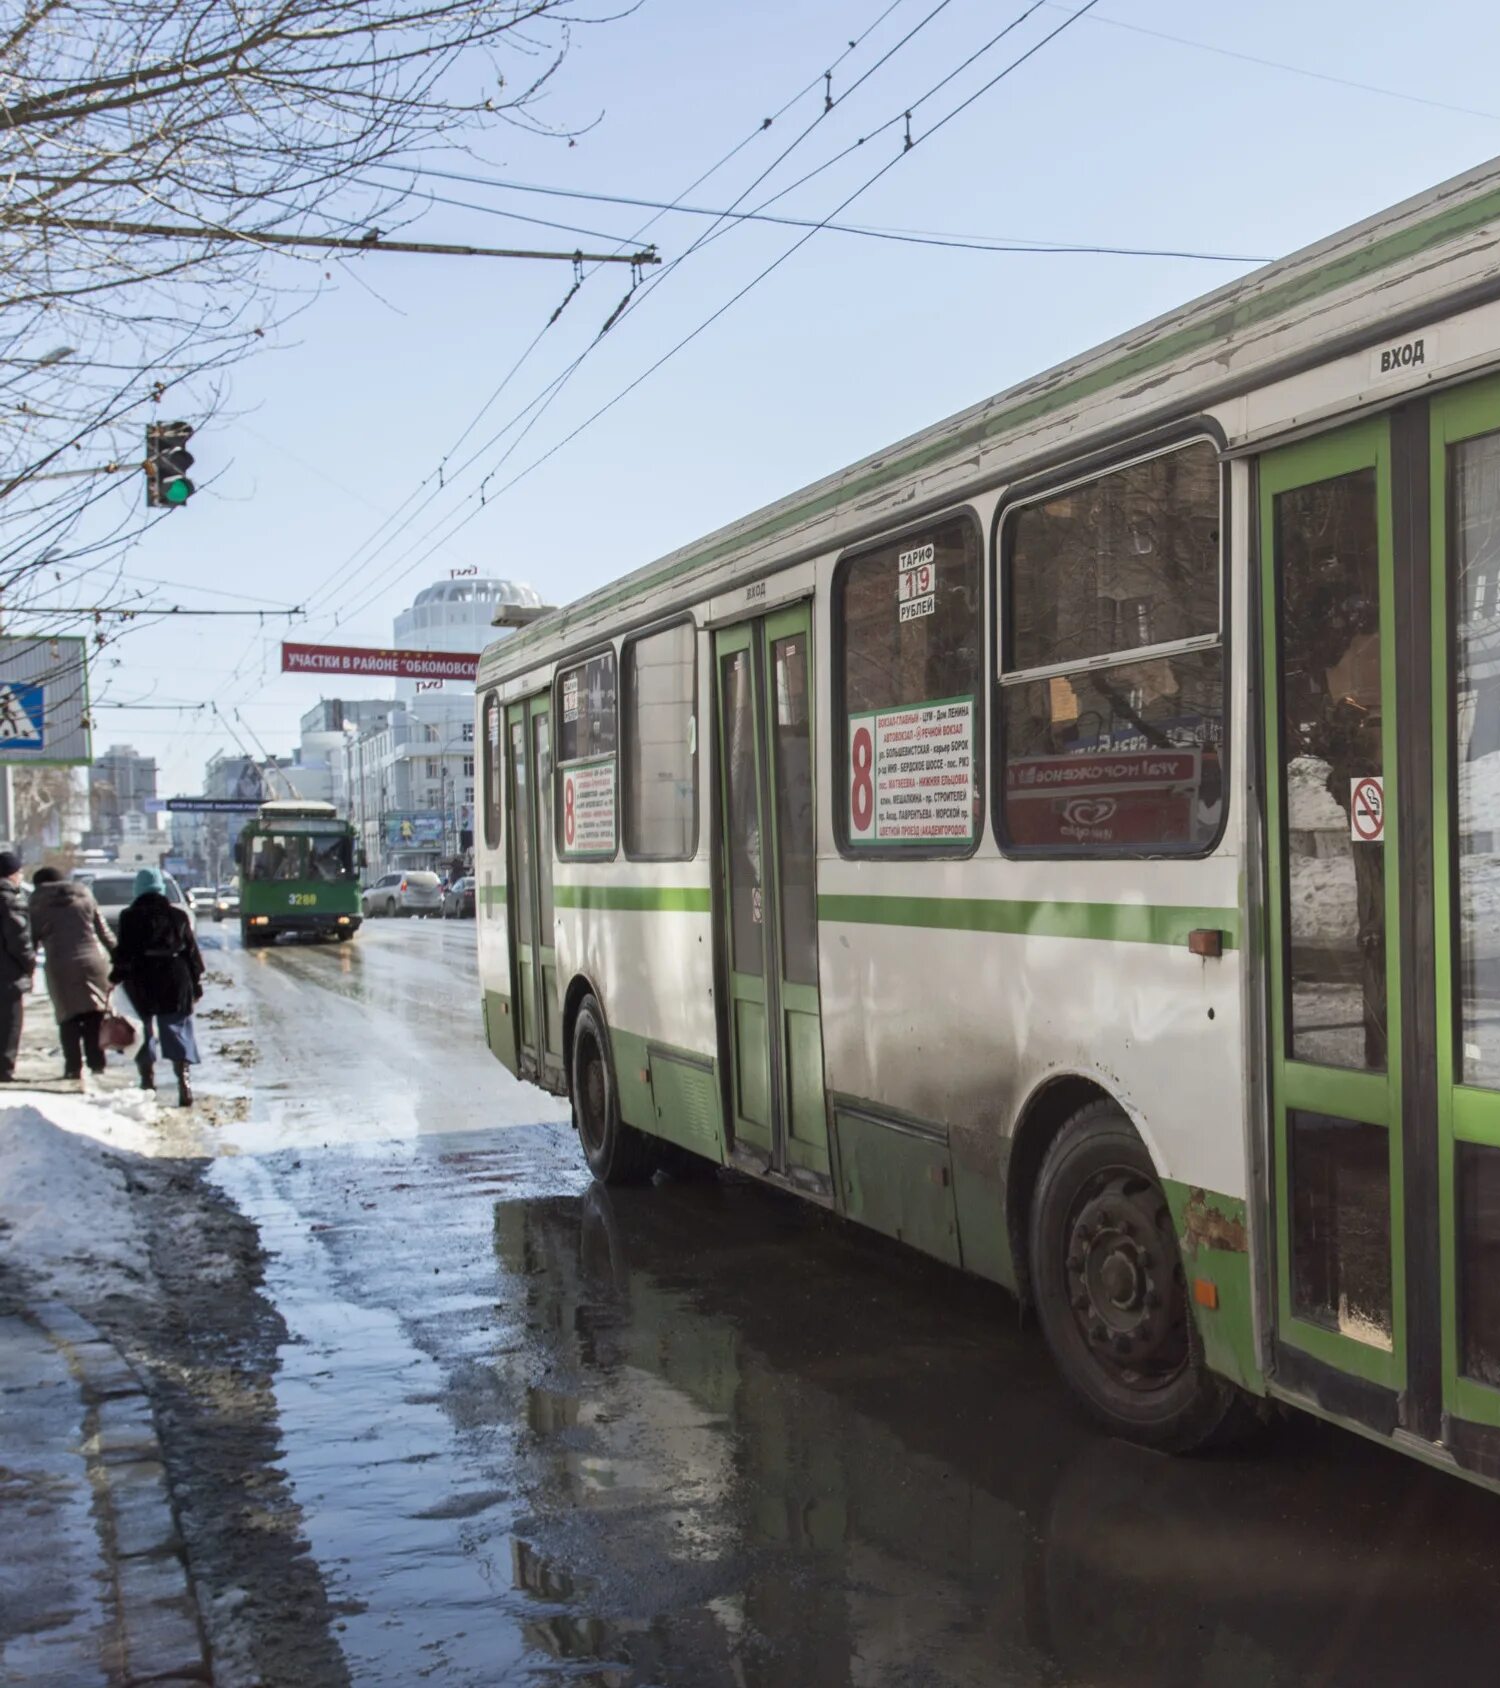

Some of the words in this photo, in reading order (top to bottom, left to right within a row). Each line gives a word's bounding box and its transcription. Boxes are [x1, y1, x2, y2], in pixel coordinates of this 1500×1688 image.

[1381, 339, 1424, 373] ВХОД
[901, 547, 932, 569] ТАРИФ
[746, 582, 766, 600] ВХОД
[905, 566, 930, 599] 19
[901, 597, 933, 620] РУБЛЕЙ
[288, 652, 340, 667] УЧАСТКИ
[342, 656, 350, 669] В
[353, 655, 398, 671] РАЙОНЕ
[852, 727, 873, 832] 8
[565, 778, 575, 845] 8
